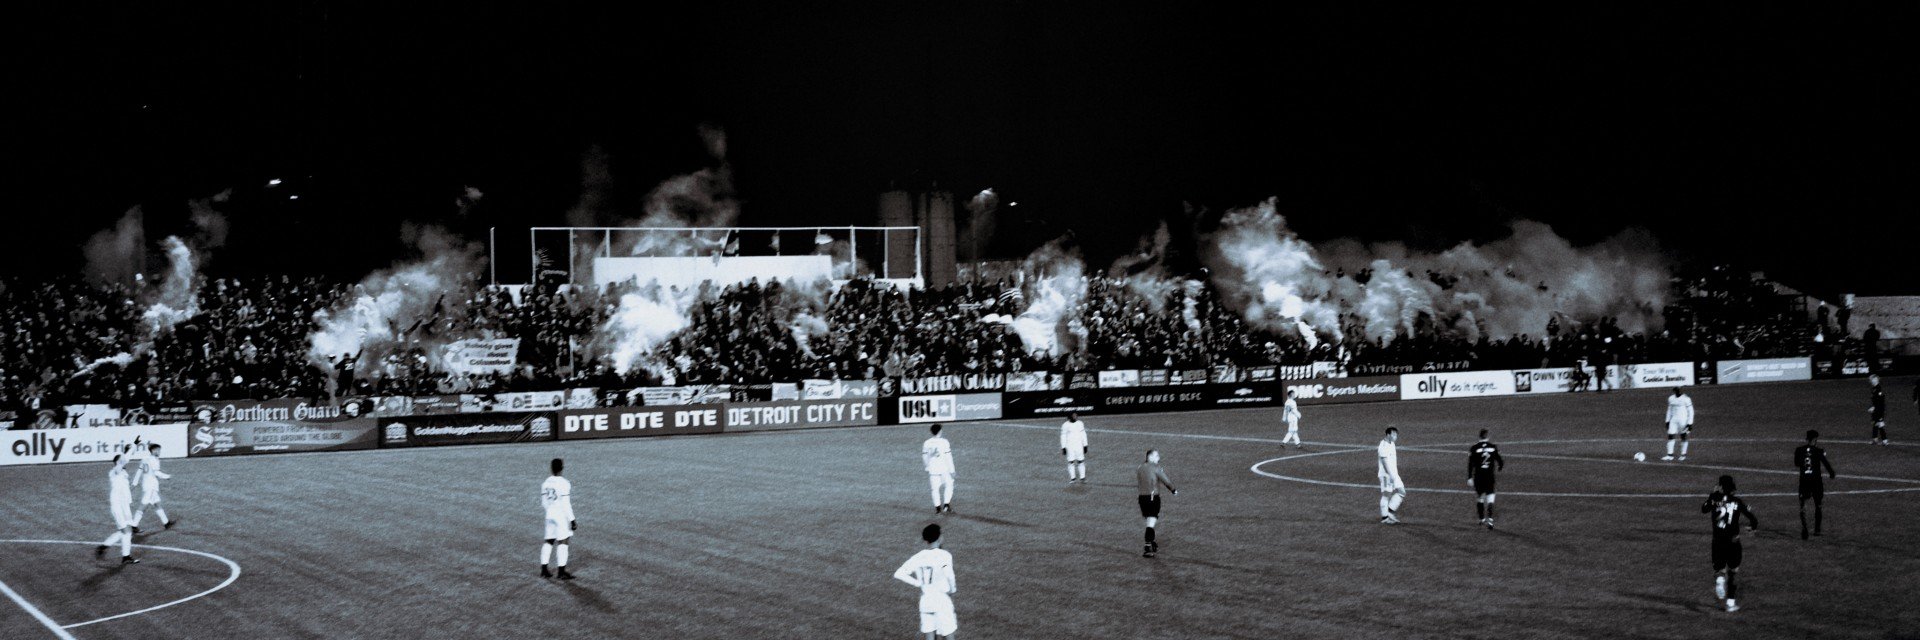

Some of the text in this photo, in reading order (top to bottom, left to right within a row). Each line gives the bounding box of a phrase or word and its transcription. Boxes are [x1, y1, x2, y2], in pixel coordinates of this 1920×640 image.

[900, 374, 962, 394] NORTHERN
[963, 372, 1005, 390] GUARD
[1326, 385, 1356, 398] Sports
[1357, 383, 1398, 394] Medicine
[1418, 375, 1448, 397] ally
[902, 400, 937, 418] USL
[1105, 396, 1135, 406] CHEVY
[1138, 394, 1175, 404] DRIVES
[217, 401, 342, 423] Northern Guard
[564, 409, 717, 433] DTE DTE DTE
[728, 402, 873, 426] DETROIT CITY FC
[413, 424, 525, 436] GoldenNuggetCasino.com
[12, 432, 152, 462] ally do it riht
[920, 565, 933, 585] 17
